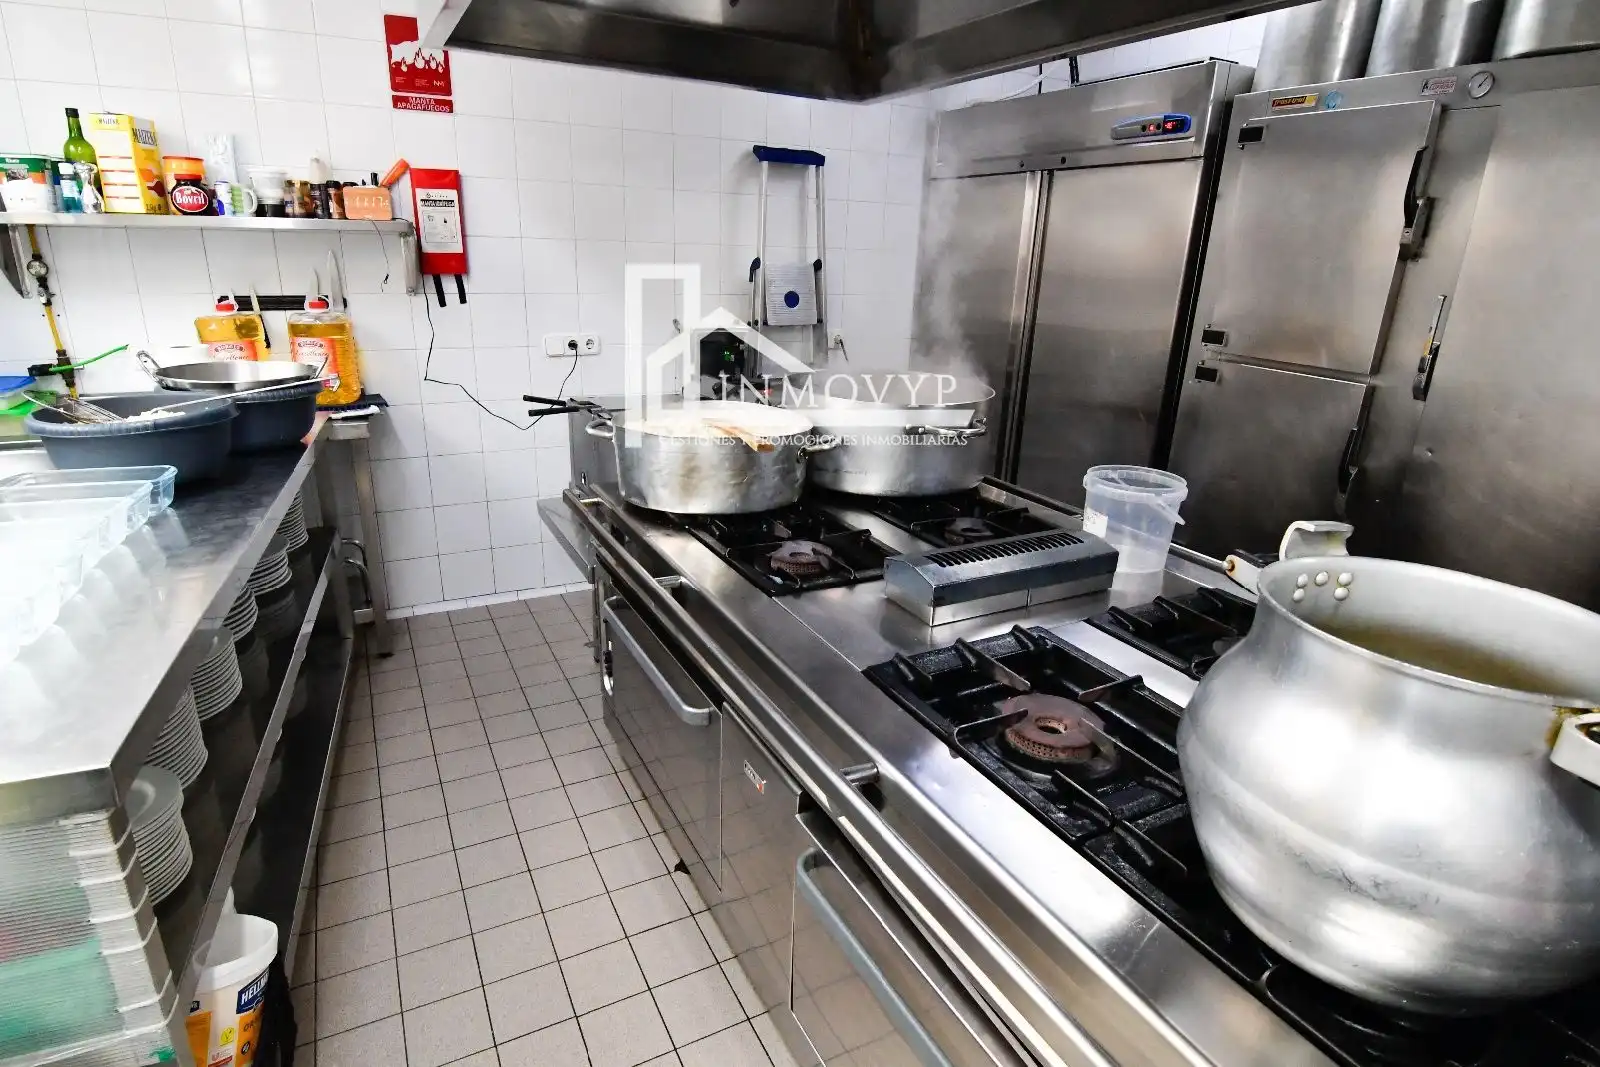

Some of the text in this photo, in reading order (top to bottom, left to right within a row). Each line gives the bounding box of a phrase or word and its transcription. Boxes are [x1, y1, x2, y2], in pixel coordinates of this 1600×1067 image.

[409, 97, 436, 105] MANTA
[397, 102, 450, 112] APAGAFUEGOS
[175, 191, 205, 205] Bovril
